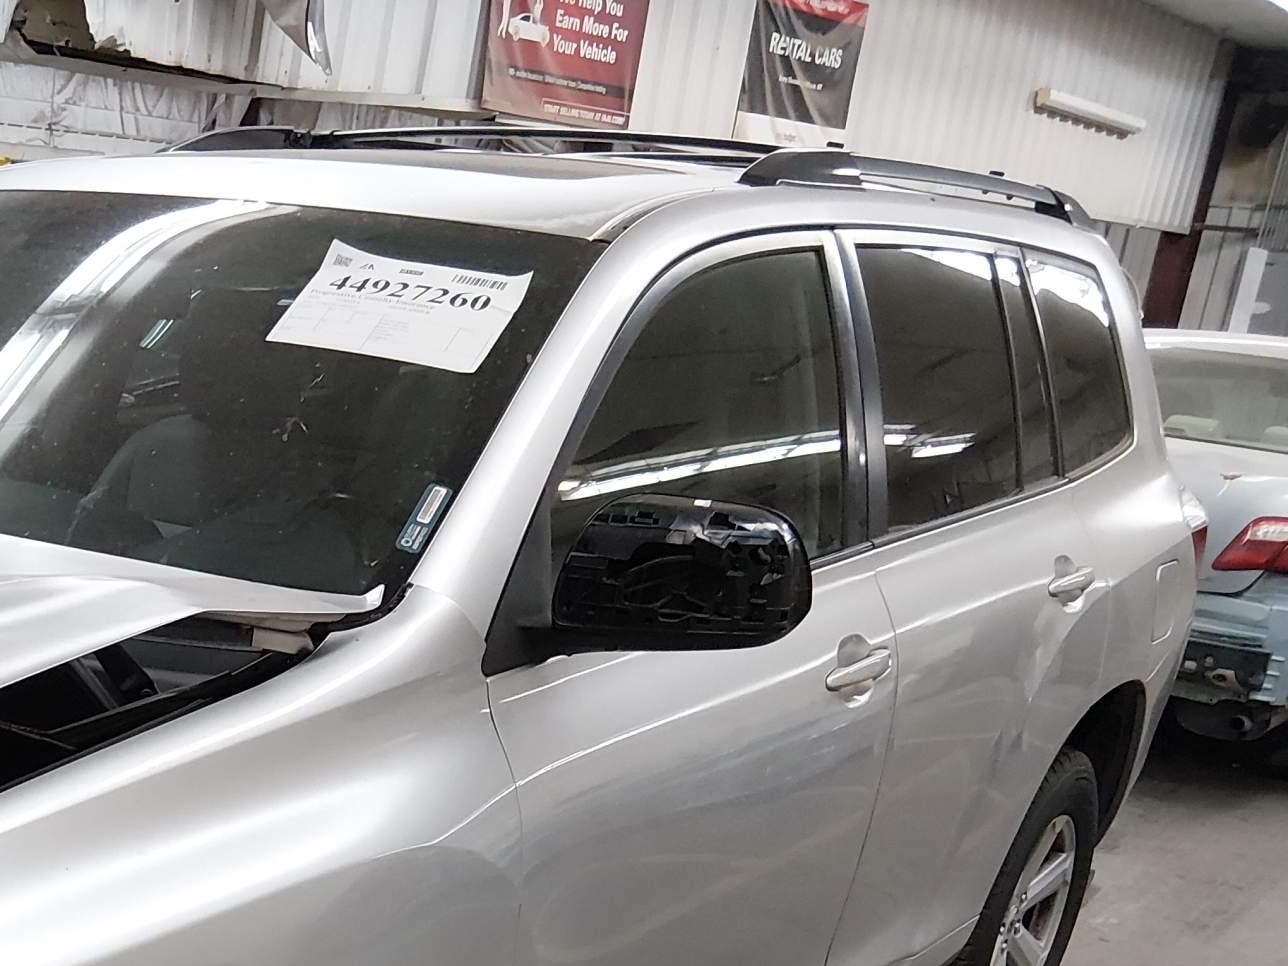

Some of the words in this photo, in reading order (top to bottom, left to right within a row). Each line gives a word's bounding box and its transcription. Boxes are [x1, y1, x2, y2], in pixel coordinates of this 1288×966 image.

[606, 0, 624, 17] You
[555, 9, 580, 32] Earn
[582, 15, 608, 38] More
[611, 23, 628, 42] For
[553, 34, 578, 56] Your
[579, 40, 616, 64] Vehicle
[769, 32, 812, 62] RENTAL
[815, 45, 843, 69] CARS
[329, 275, 492, 311] 44927260
